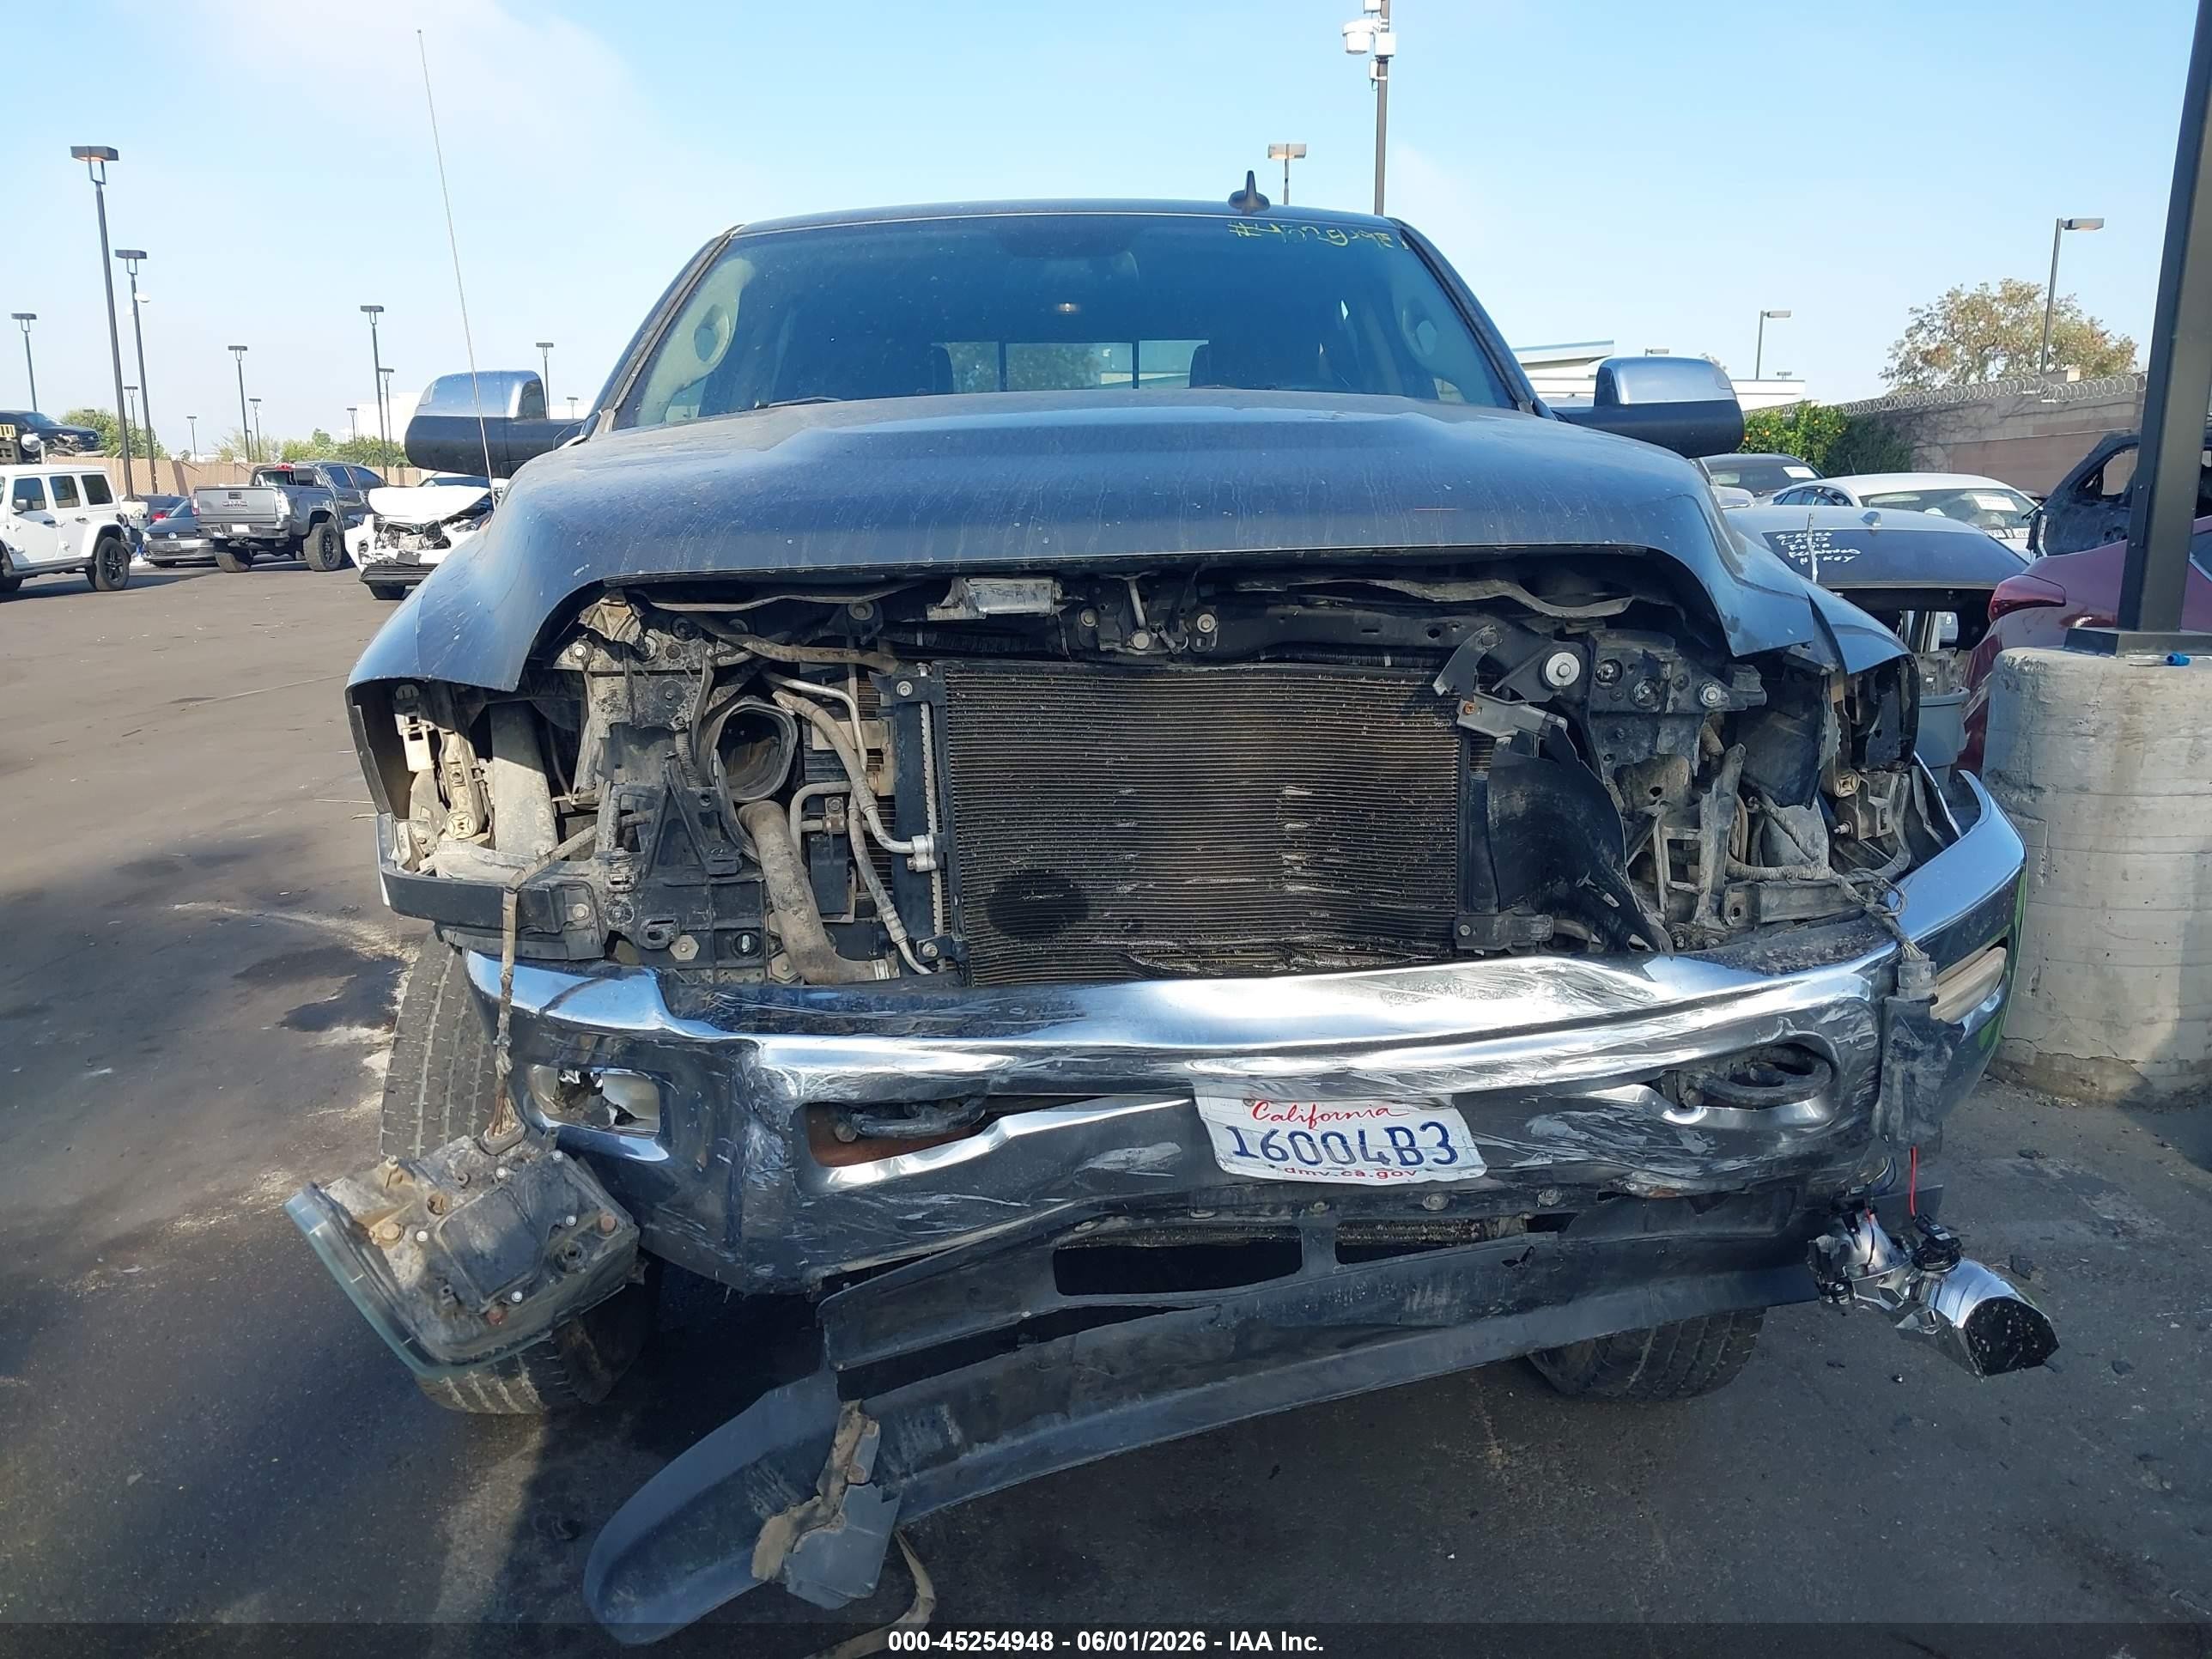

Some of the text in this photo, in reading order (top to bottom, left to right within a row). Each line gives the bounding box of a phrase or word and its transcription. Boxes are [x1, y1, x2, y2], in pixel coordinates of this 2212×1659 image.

[1251, 1101, 1410, 1131] California
[1225, 1121, 1459, 1167] 16004B3
[1284, 1166, 1418, 1179] dmv.ca.gov
